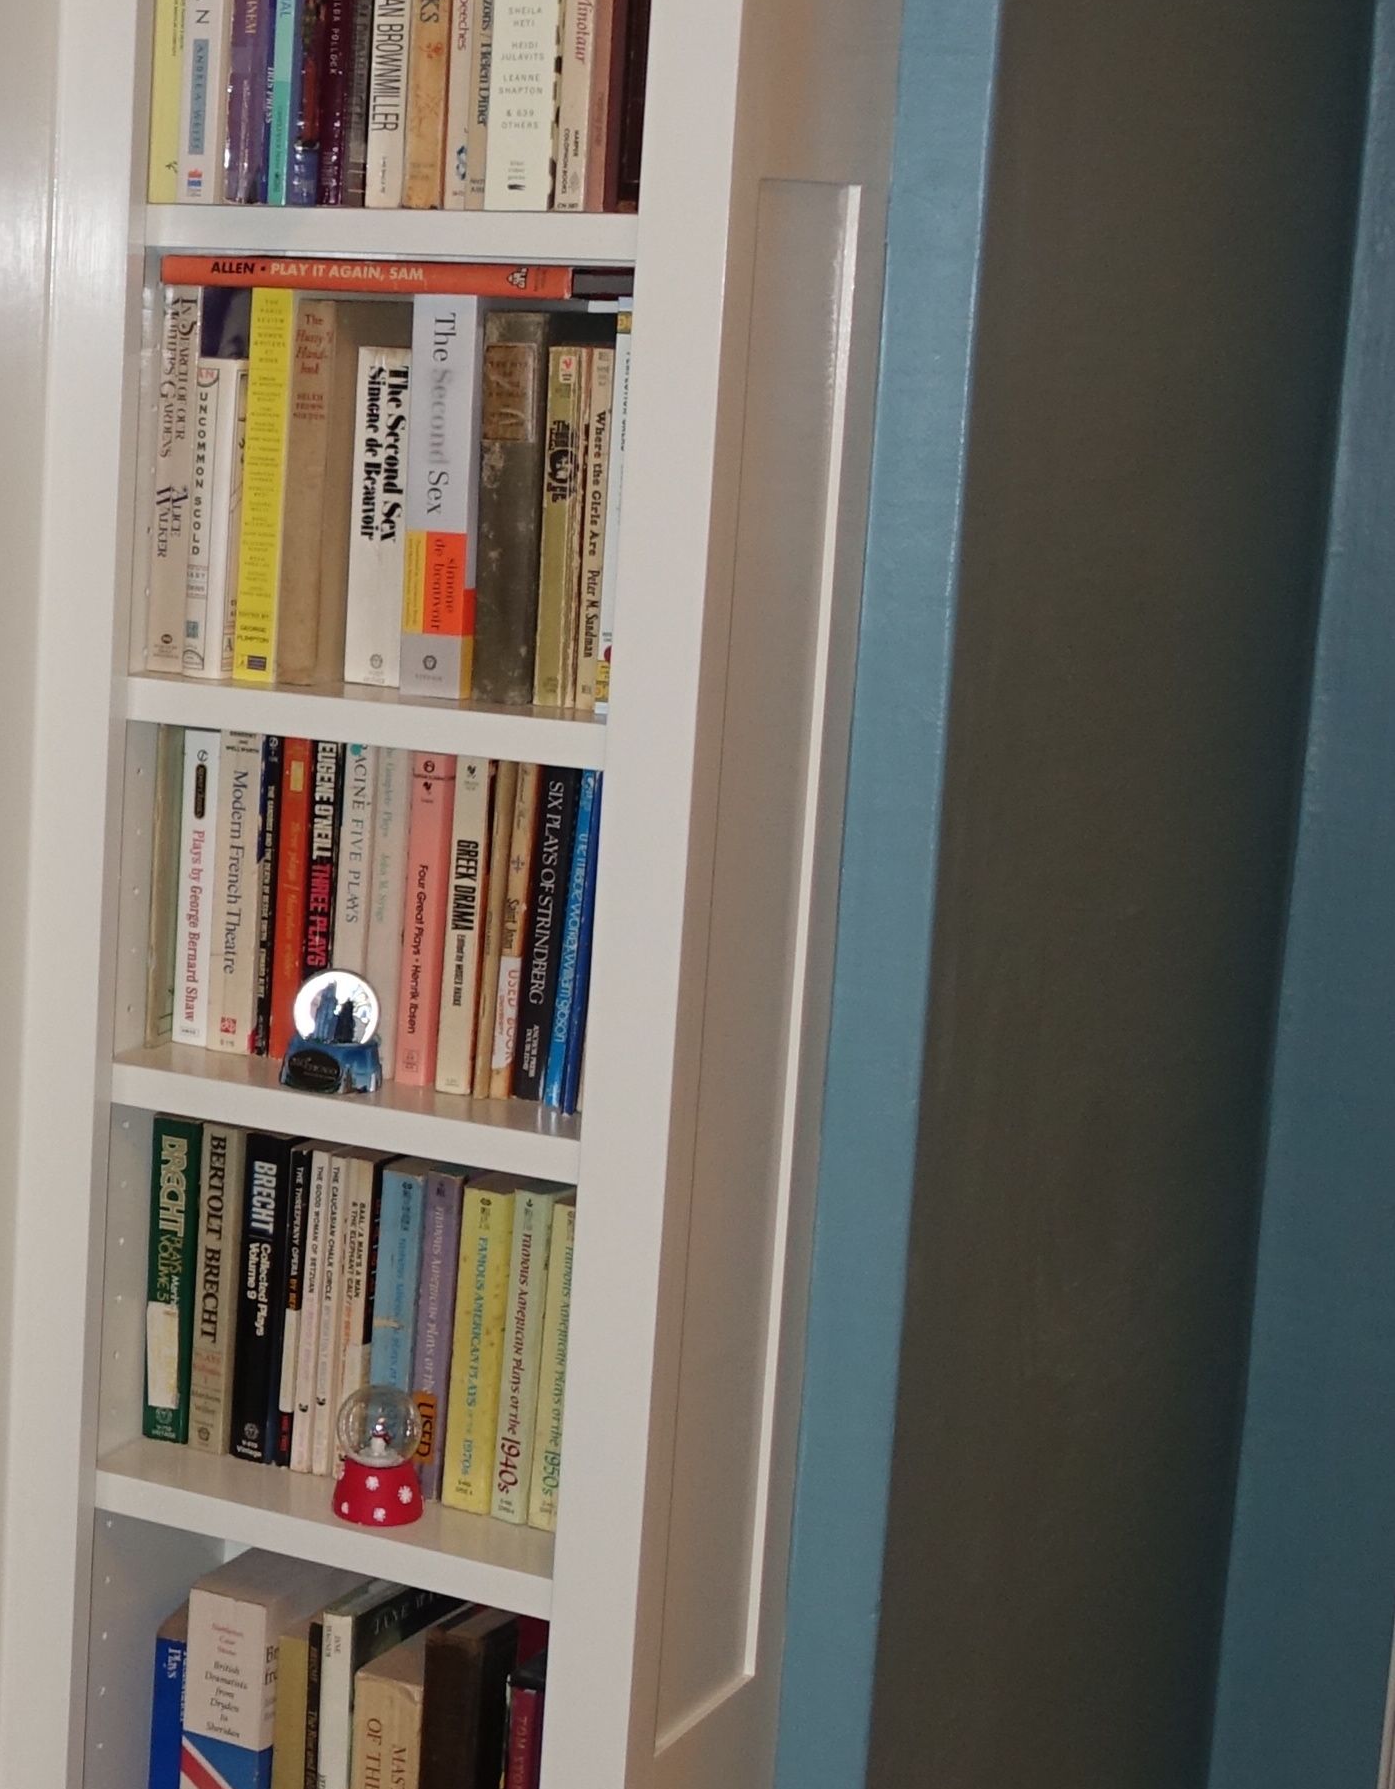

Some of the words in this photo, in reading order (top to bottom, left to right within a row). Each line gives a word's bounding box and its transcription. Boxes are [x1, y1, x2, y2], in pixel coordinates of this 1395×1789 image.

[371, 23, 400, 134] BROWNMILLER
[210, 261, 255, 274] ALLEN
[270, 263, 304, 277] PLAY
[307, 264, 324, 278] IT
[327, 265, 385, 280] AGAIN,
[388, 265, 423, 280] SAM
[432, 311, 457, 361] The
[365, 366, 385, 434] Simone
[388, 366, 409, 409] The
[428, 366, 452, 464] Second
[365, 438, 379, 458] de
[385, 413, 406, 495] Second
[361, 461, 379, 540] Beauvoir
[426, 470, 449, 514] Sex
[381, 499, 403, 542] Sex
[316, 742, 337, 803] EUGENE
[549, 781, 564, 809] SIX
[230, 770, 249, 843] Modern
[313, 805, 334, 860] O'NEILL
[457, 839, 479, 881] GREEK
[542, 816, 562, 863] PLAYS
[226, 846, 244, 905] French
[310, 864, 332, 912] THREE
[539, 865, 557, 894] OF
[451, 884, 476, 930] DRAMA
[223, 909, 241, 974] Theatre
[306, 915, 329, 966] PLAYS
[527, 896, 553, 1006] STRINDBERG
[207, 1135, 227, 1243] BERTOLT
[251, 1161, 277, 1236] BRECHT
[202, 1246, 220, 1343] BRECHT
[498, 1435, 521, 1492] 1940s
[369, 1717, 383, 1749] OF
